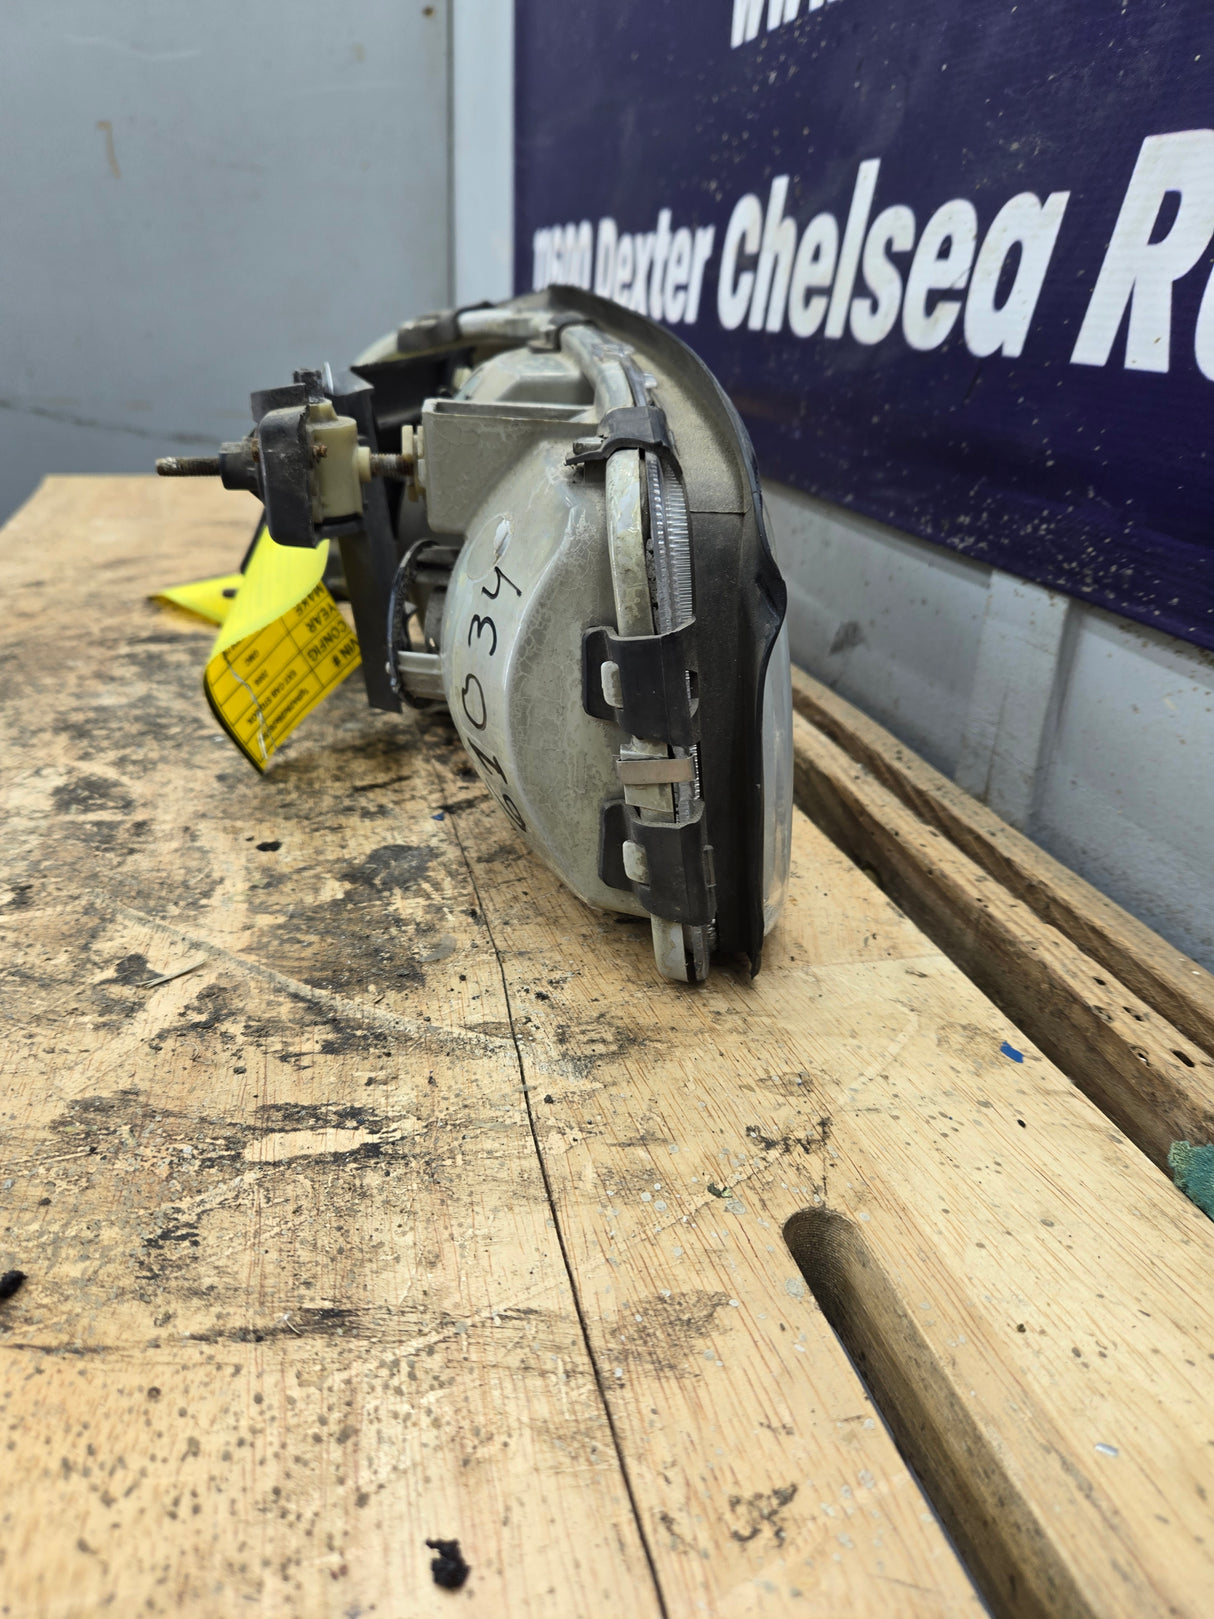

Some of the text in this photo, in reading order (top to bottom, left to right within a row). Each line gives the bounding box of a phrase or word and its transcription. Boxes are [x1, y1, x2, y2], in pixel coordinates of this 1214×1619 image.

[594, 207, 715, 324] Dexter
[717, 158, 1070, 358] Chelsea
[1070, 128, 1214, 383] R
[295, 584, 324, 616] MAKE
[305, 602, 336, 633] YEAR
[307, 618, 347, 662] CONFIG
[341, 637, 359, 658] VIN
